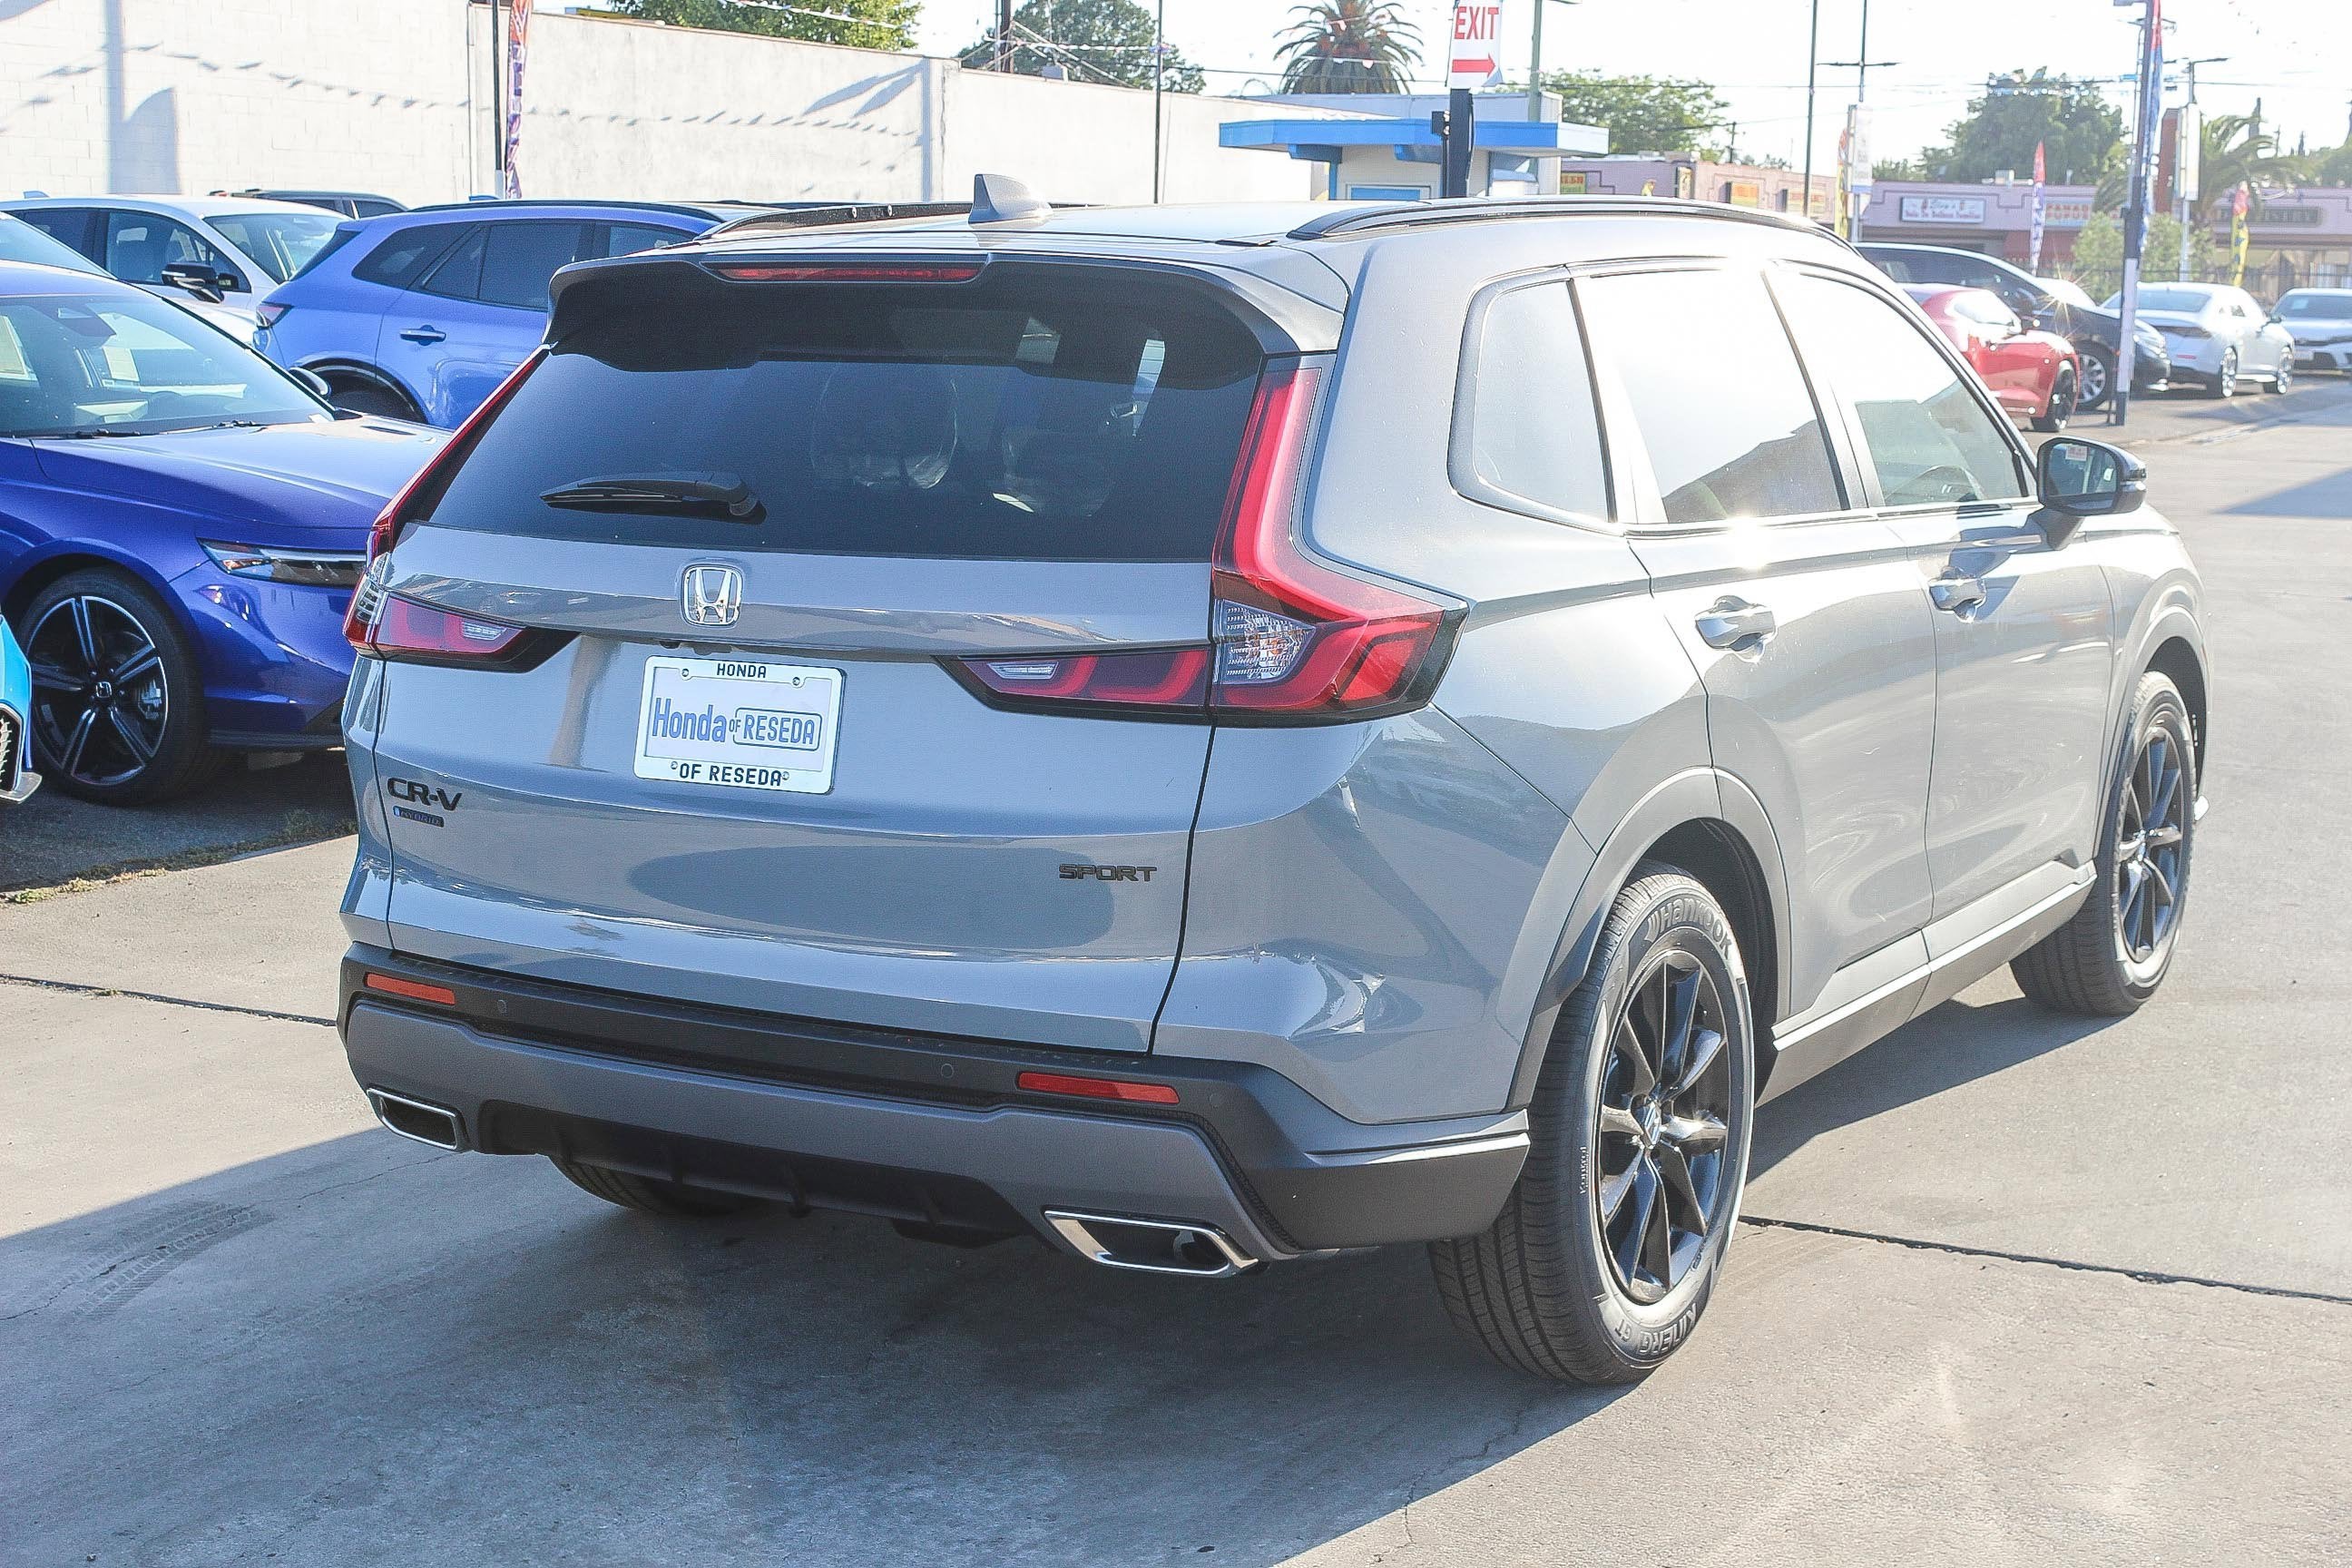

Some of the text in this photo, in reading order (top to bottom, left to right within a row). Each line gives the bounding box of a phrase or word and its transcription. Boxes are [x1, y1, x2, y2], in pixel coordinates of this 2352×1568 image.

[1454, 6, 1499, 40] EXIT
[717, 663, 767, 679] HONDA
[652, 697, 815, 745] Honda OF RESEDA
[680, 763, 782, 787] OF RESEDA
[387, 777, 463, 811] CR-V
[1059, 864, 1157, 882] SPORT
